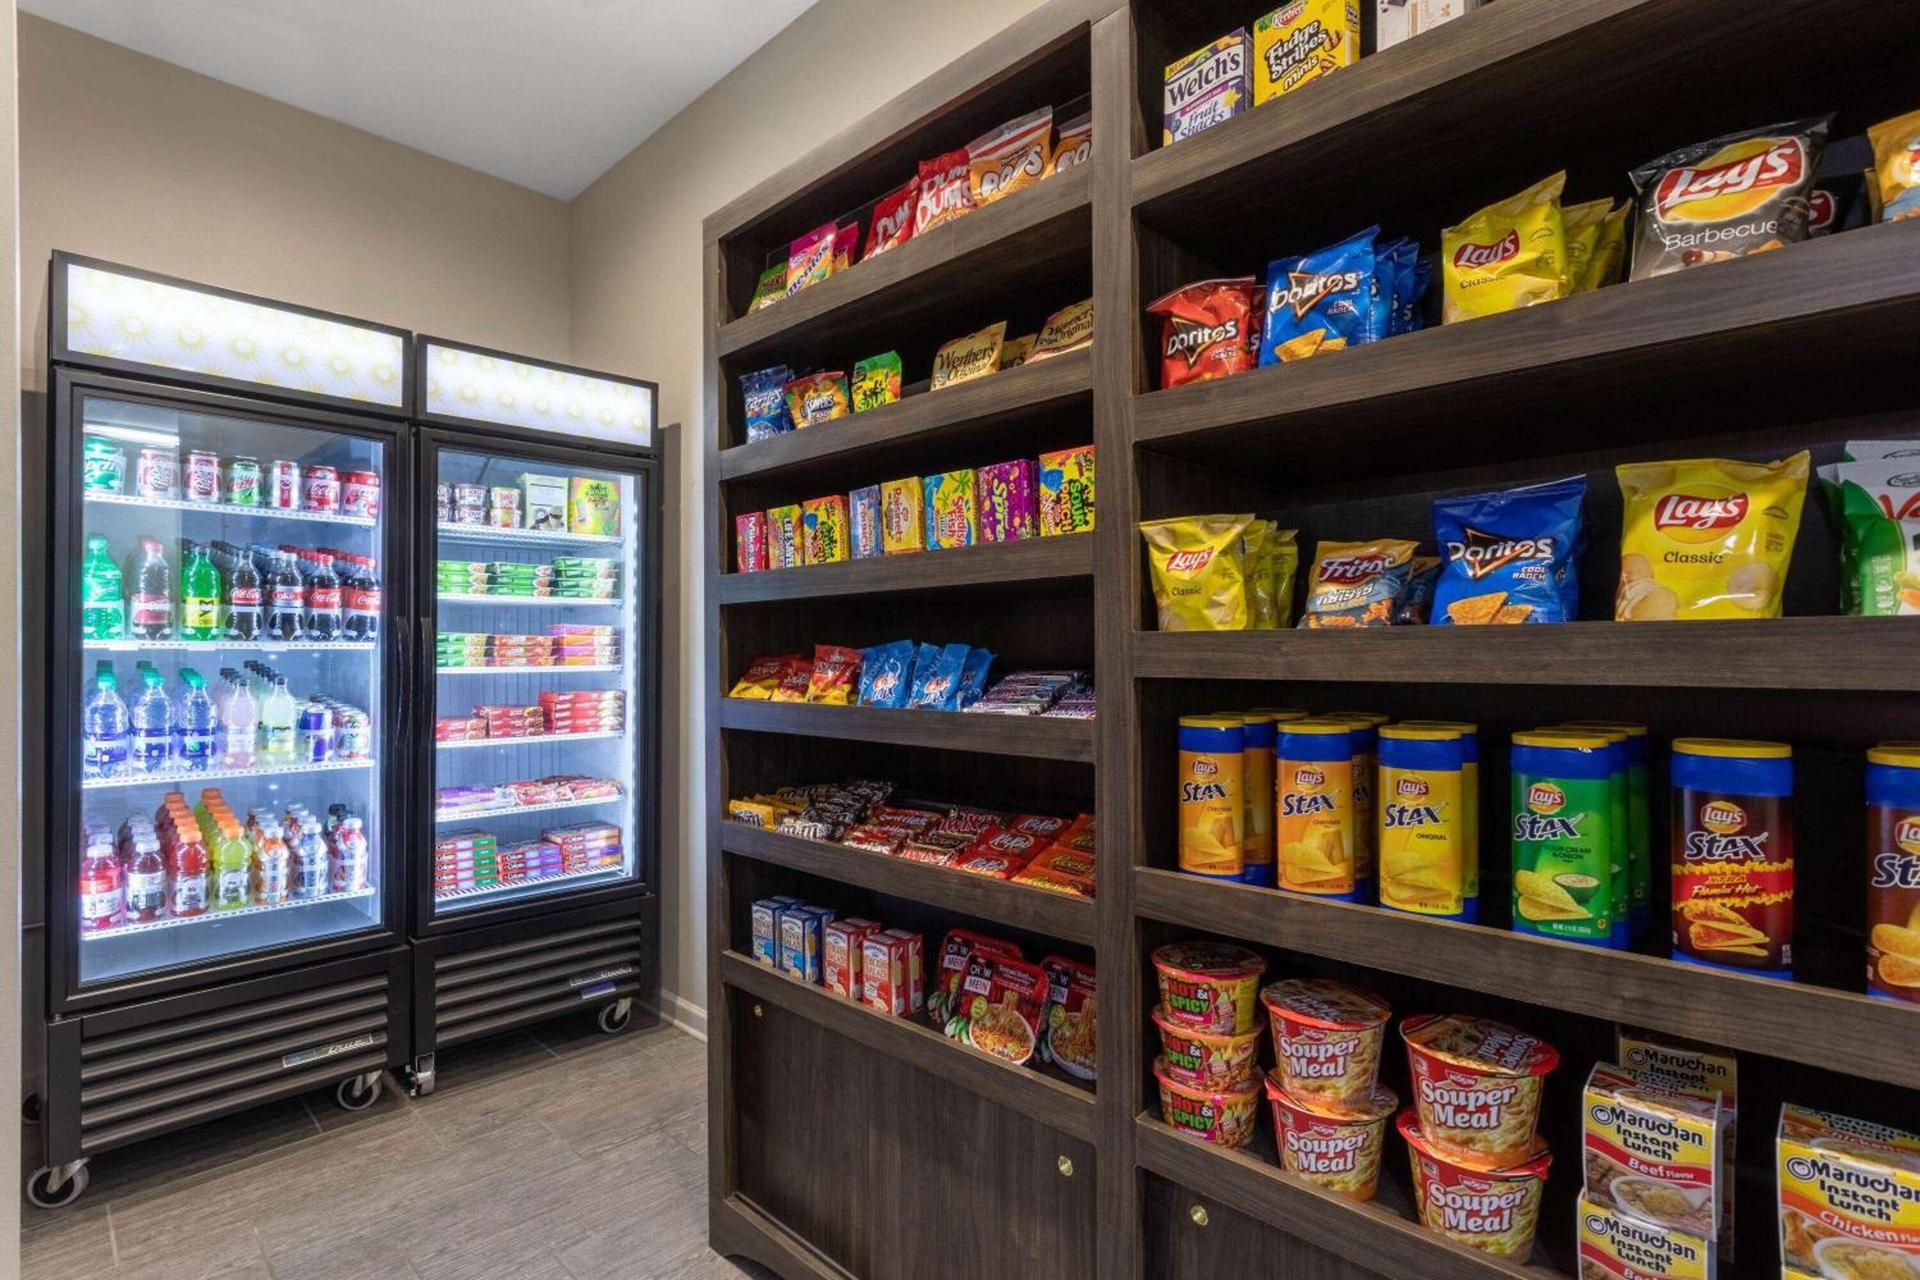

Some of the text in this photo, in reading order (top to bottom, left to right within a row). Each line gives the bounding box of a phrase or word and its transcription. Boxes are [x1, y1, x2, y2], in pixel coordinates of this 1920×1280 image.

[1265, 20, 1319, 65] Fudge
[1270, 29, 1327, 79] Stripes
[1167, 52, 1241, 106] Welch's
[1284, 55, 1319, 91] minis
[1187, 99, 1219, 127] Fruit
[1665, 218, 1779, 251] Barbecue
[1270, 270, 1361, 312] Doritos
[1167, 320, 1238, 356] Doritos
[1060, 482, 1072, 531] PATCH
[1070, 482, 1084, 526] SOUR
[1659, 495, 1746, 530] Lay's
[1446, 538, 1554, 563] Doritos
[1663, 551, 1724, 565] Classic
[1171, 584, 1203, 597] Classic
[1704, 806, 1743, 825] Lay's
[1416, 833, 1447, 841] ORIGINAL
[1168, 979, 1208, 999] HOT &
[1170, 993, 1210, 1014] SPICY
[1280, 1036, 1359, 1062] Souper
[1644, 1049, 1728, 1077] Maruchan
[1289, 1056, 1346, 1078] Meal
[1420, 1078, 1517, 1111] Souper
[1200, 1104, 1213, 1117] &
[1433, 1103, 1501, 1128] Meal
[1610, 1107, 1705, 1146] Maruchan
[1616, 1123, 1680, 1153] Instant
[1286, 1130, 1369, 1157] Souper
[1623, 1137, 1673, 1162] Lunch
[1297, 1151, 1354, 1173] Meal
[1628, 1156, 1666, 1178] Beef
[1429, 1183, 1528, 1215] Souper
[1820, 1180, 1901, 1212] Instant
[1828, 1194, 1892, 1222] Lunch
[1443, 1208, 1513, 1232] Meal
[1820, 1210, 1899, 1243] Chicken
[1604, 1216, 1697, 1260] Maruchan
[1610, 1235, 1673, 1266] Instant
[1617, 1248, 1667, 1275] Lunch
